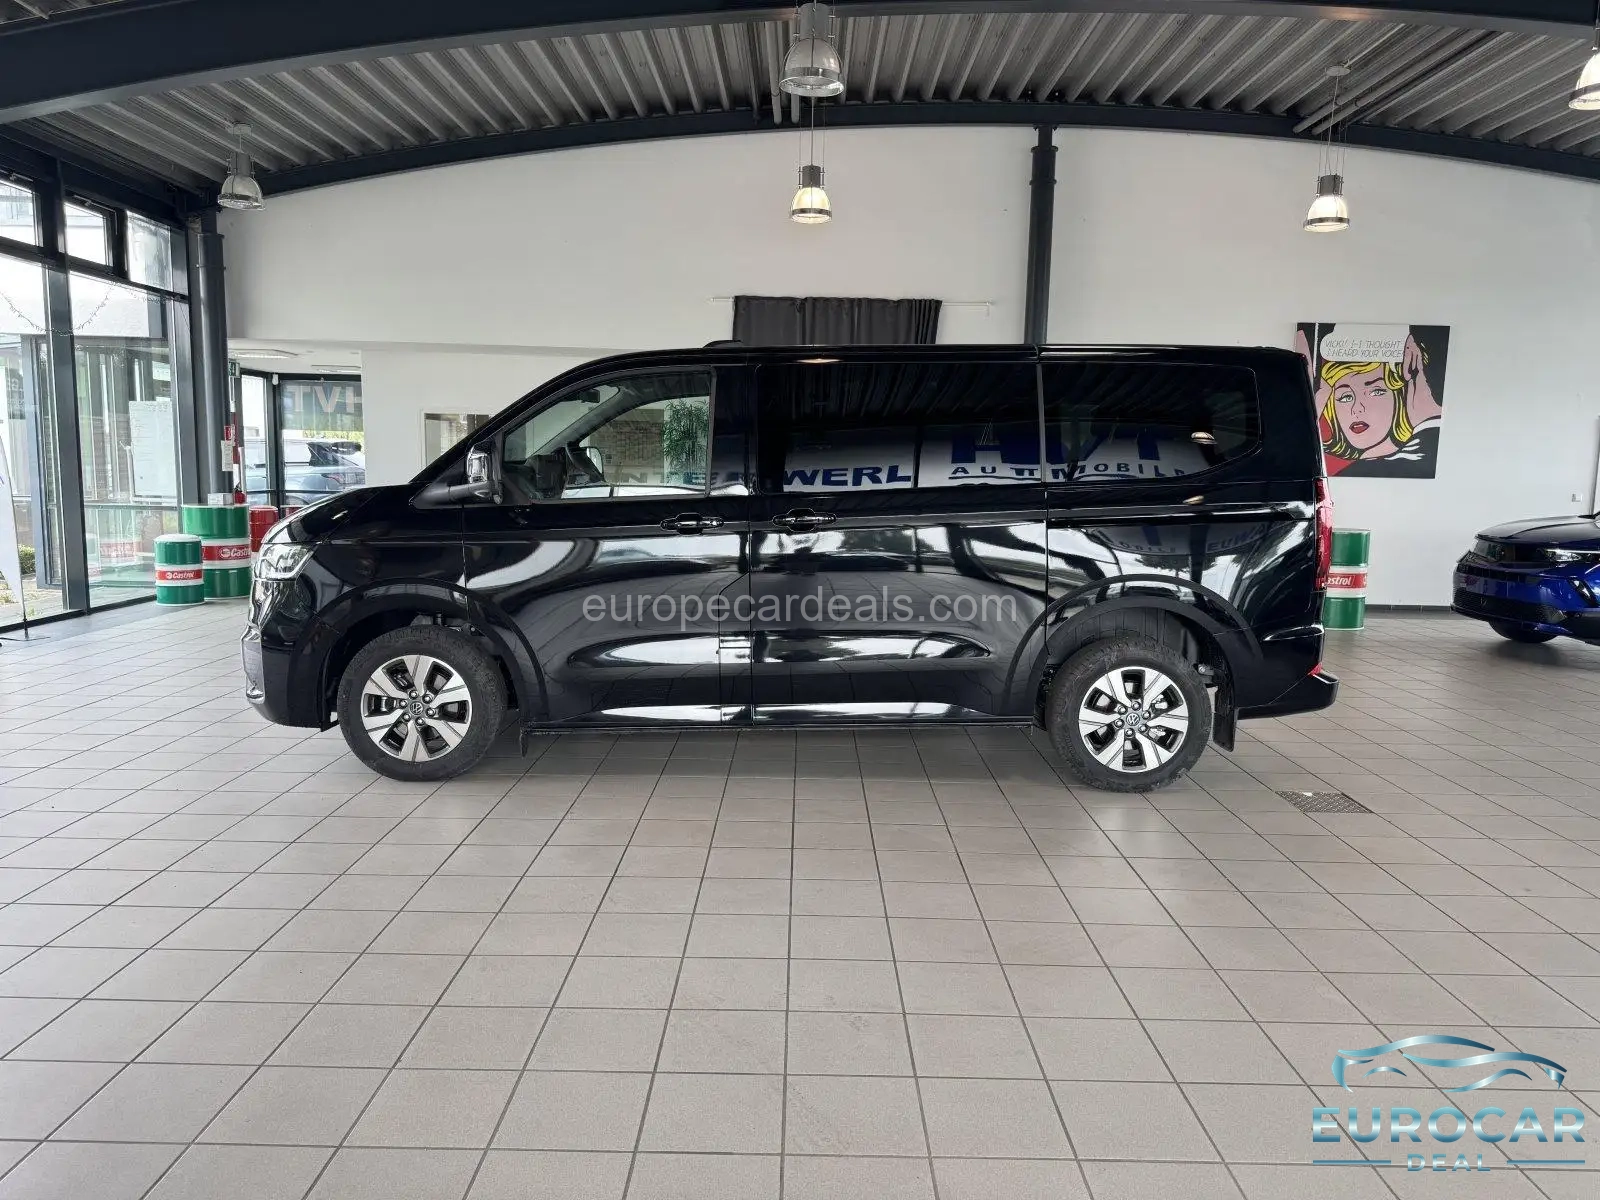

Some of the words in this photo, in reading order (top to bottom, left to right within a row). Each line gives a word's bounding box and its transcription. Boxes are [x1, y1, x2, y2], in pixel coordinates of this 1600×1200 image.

[1366, 340, 1402, 350] THOUGHT
[1361, 349, 1380, 358] YOUR
[784, 465, 912, 487] WERL
[172, 571, 195, 580] Castrol
[1327, 576, 1352, 586] astrol
